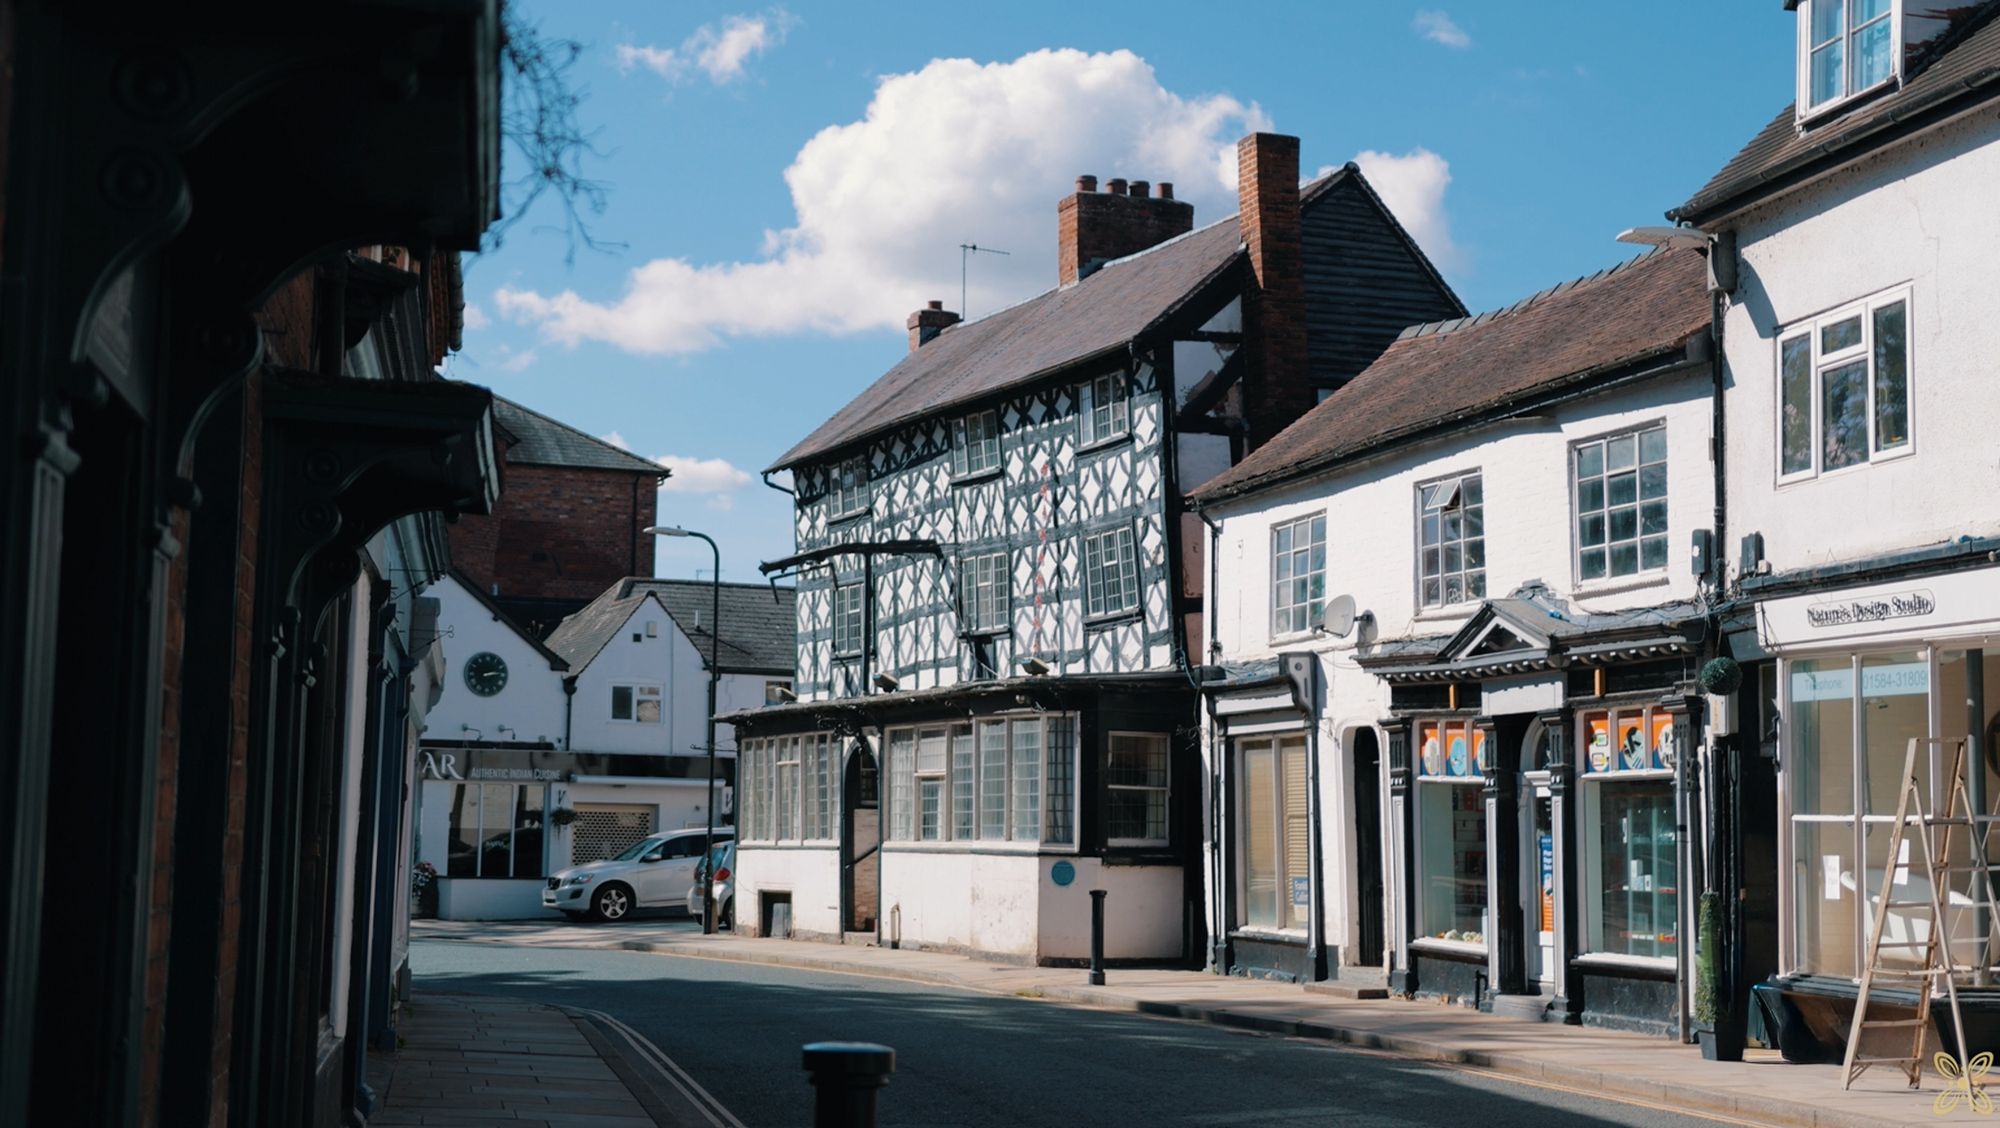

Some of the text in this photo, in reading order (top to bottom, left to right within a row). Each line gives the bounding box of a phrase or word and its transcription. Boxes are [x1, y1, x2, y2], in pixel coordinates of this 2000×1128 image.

[1852, 602, 1891, 622] Design
[1891, 593, 1932, 615] Studio
[471, 767, 560, 780] AUTHENTIC INDIAN CUISINE
